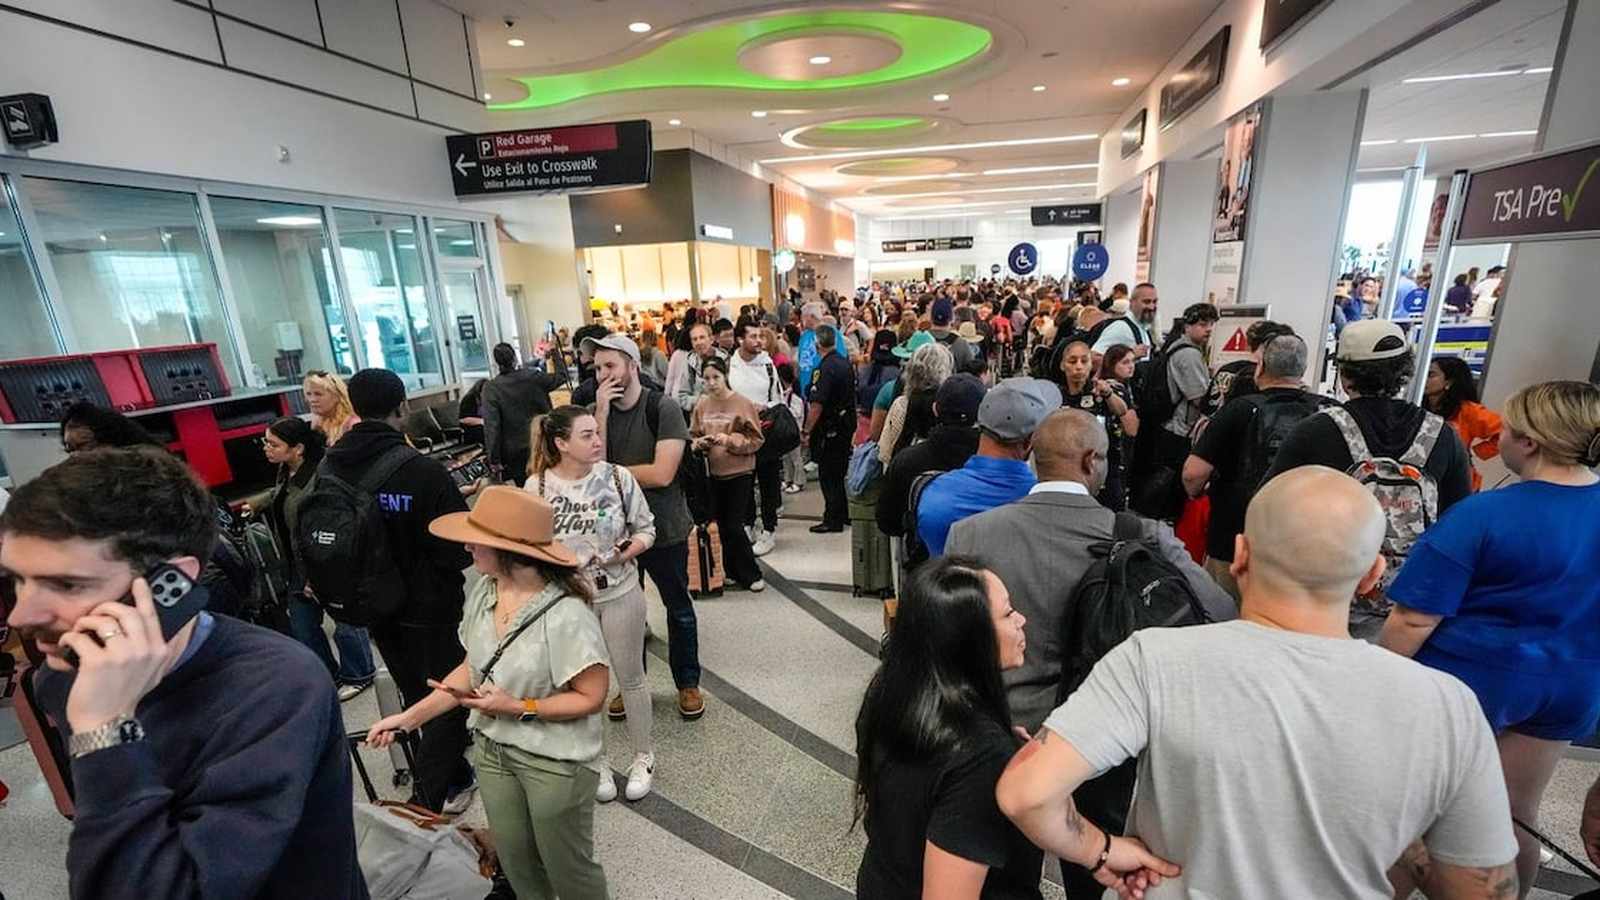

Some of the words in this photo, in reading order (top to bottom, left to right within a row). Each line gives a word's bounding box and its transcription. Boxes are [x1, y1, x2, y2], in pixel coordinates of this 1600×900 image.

[495, 136, 515, 146] Red
[517, 133, 552, 146] Garage
[480, 140, 492, 155] P
[481, 164, 502, 178] Use
[504, 161, 525, 176] Exit
[527, 161, 539, 174] to
[541, 155, 598, 174] Crosswalk
[551, 175, 560, 185] de
[1492, 187, 1522, 222] TSA
